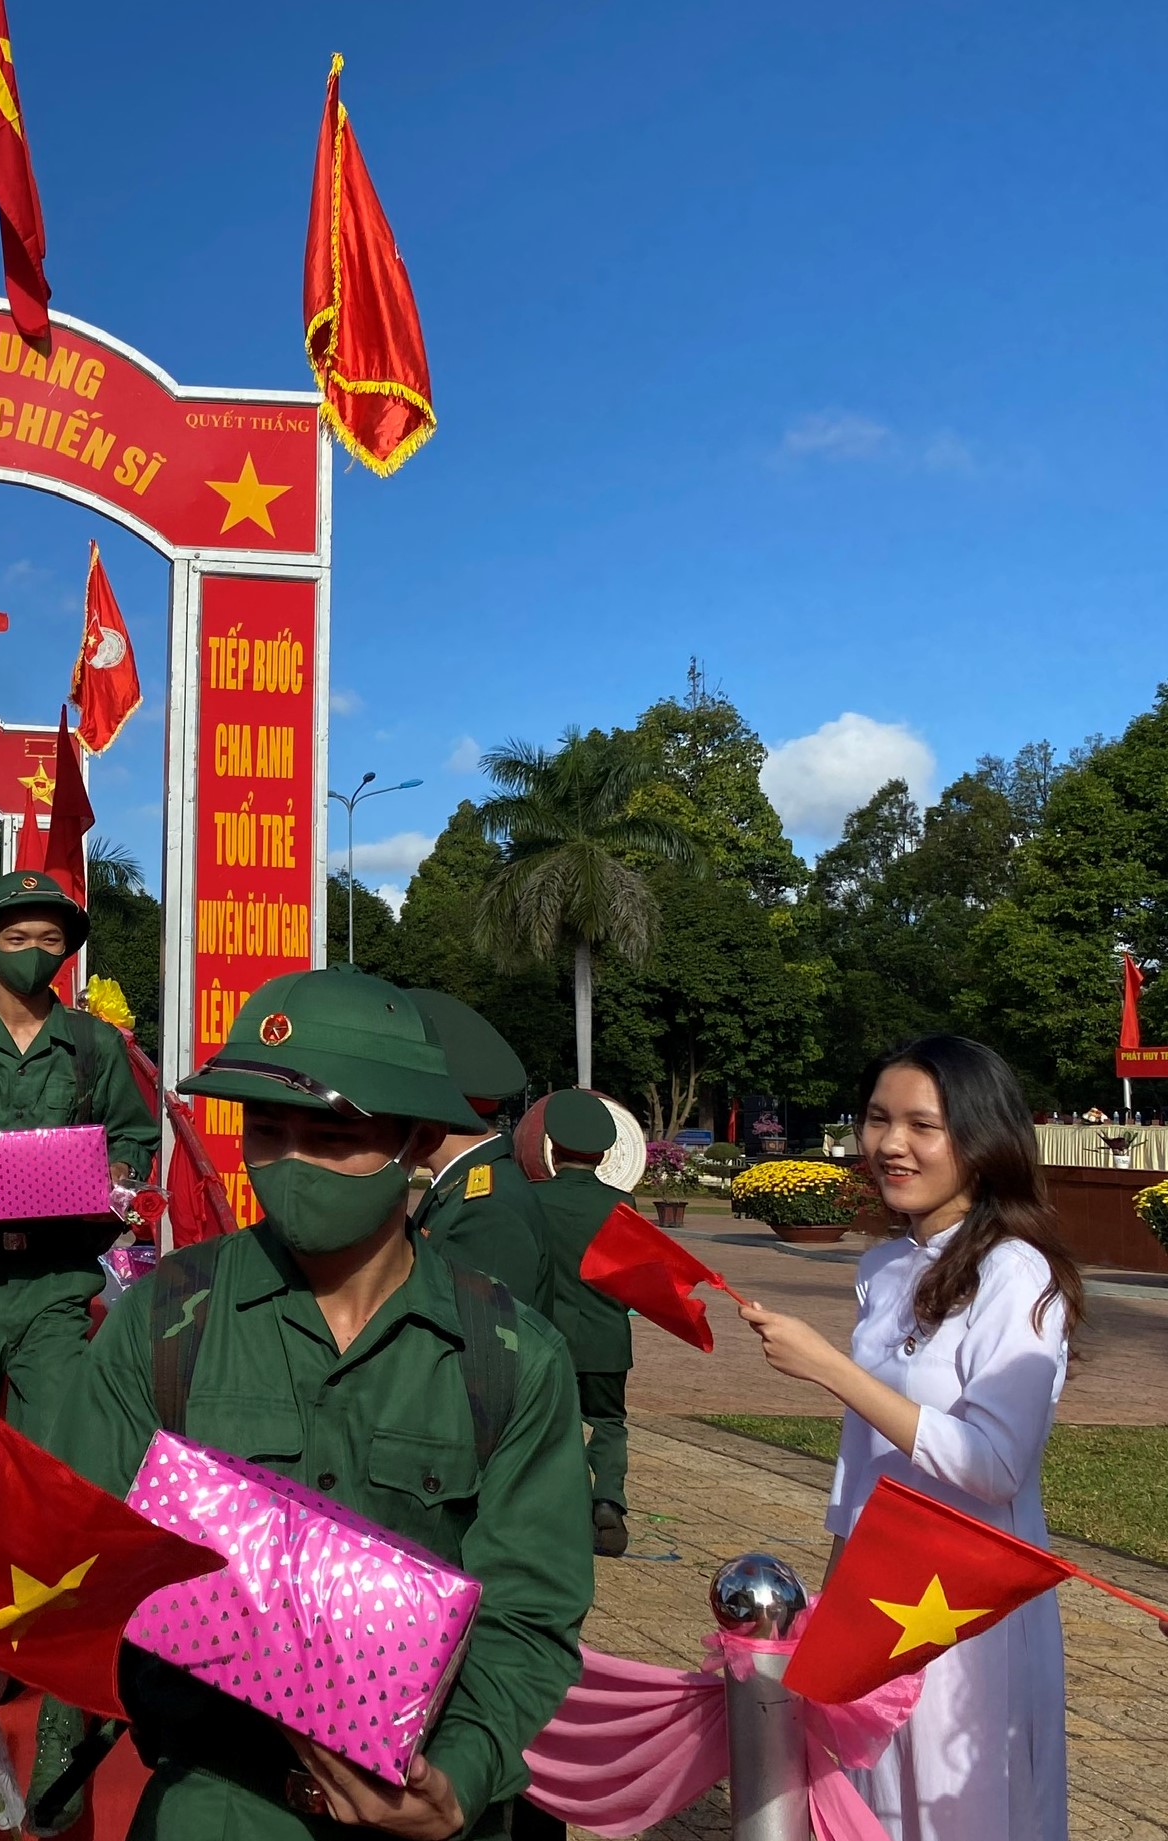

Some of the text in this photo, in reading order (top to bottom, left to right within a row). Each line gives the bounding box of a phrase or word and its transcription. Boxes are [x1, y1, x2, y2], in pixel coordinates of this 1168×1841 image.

[185, 410, 310, 433] QUYẾT THẮNG
[113, 447, 167, 496] SĨ
[209, 624, 304, 694] TIẾP BƯỚC
[215, 723, 294, 779] CHA ANH
[214, 792, 295, 868] TUỔI TRẺ
[198, 890, 243, 964] HUYỆN
[201, 976, 235, 1044] LÊN
[1121, 1051, 1141, 1061] PHÁT
[1143, 1052, 1158, 1061] HUY
